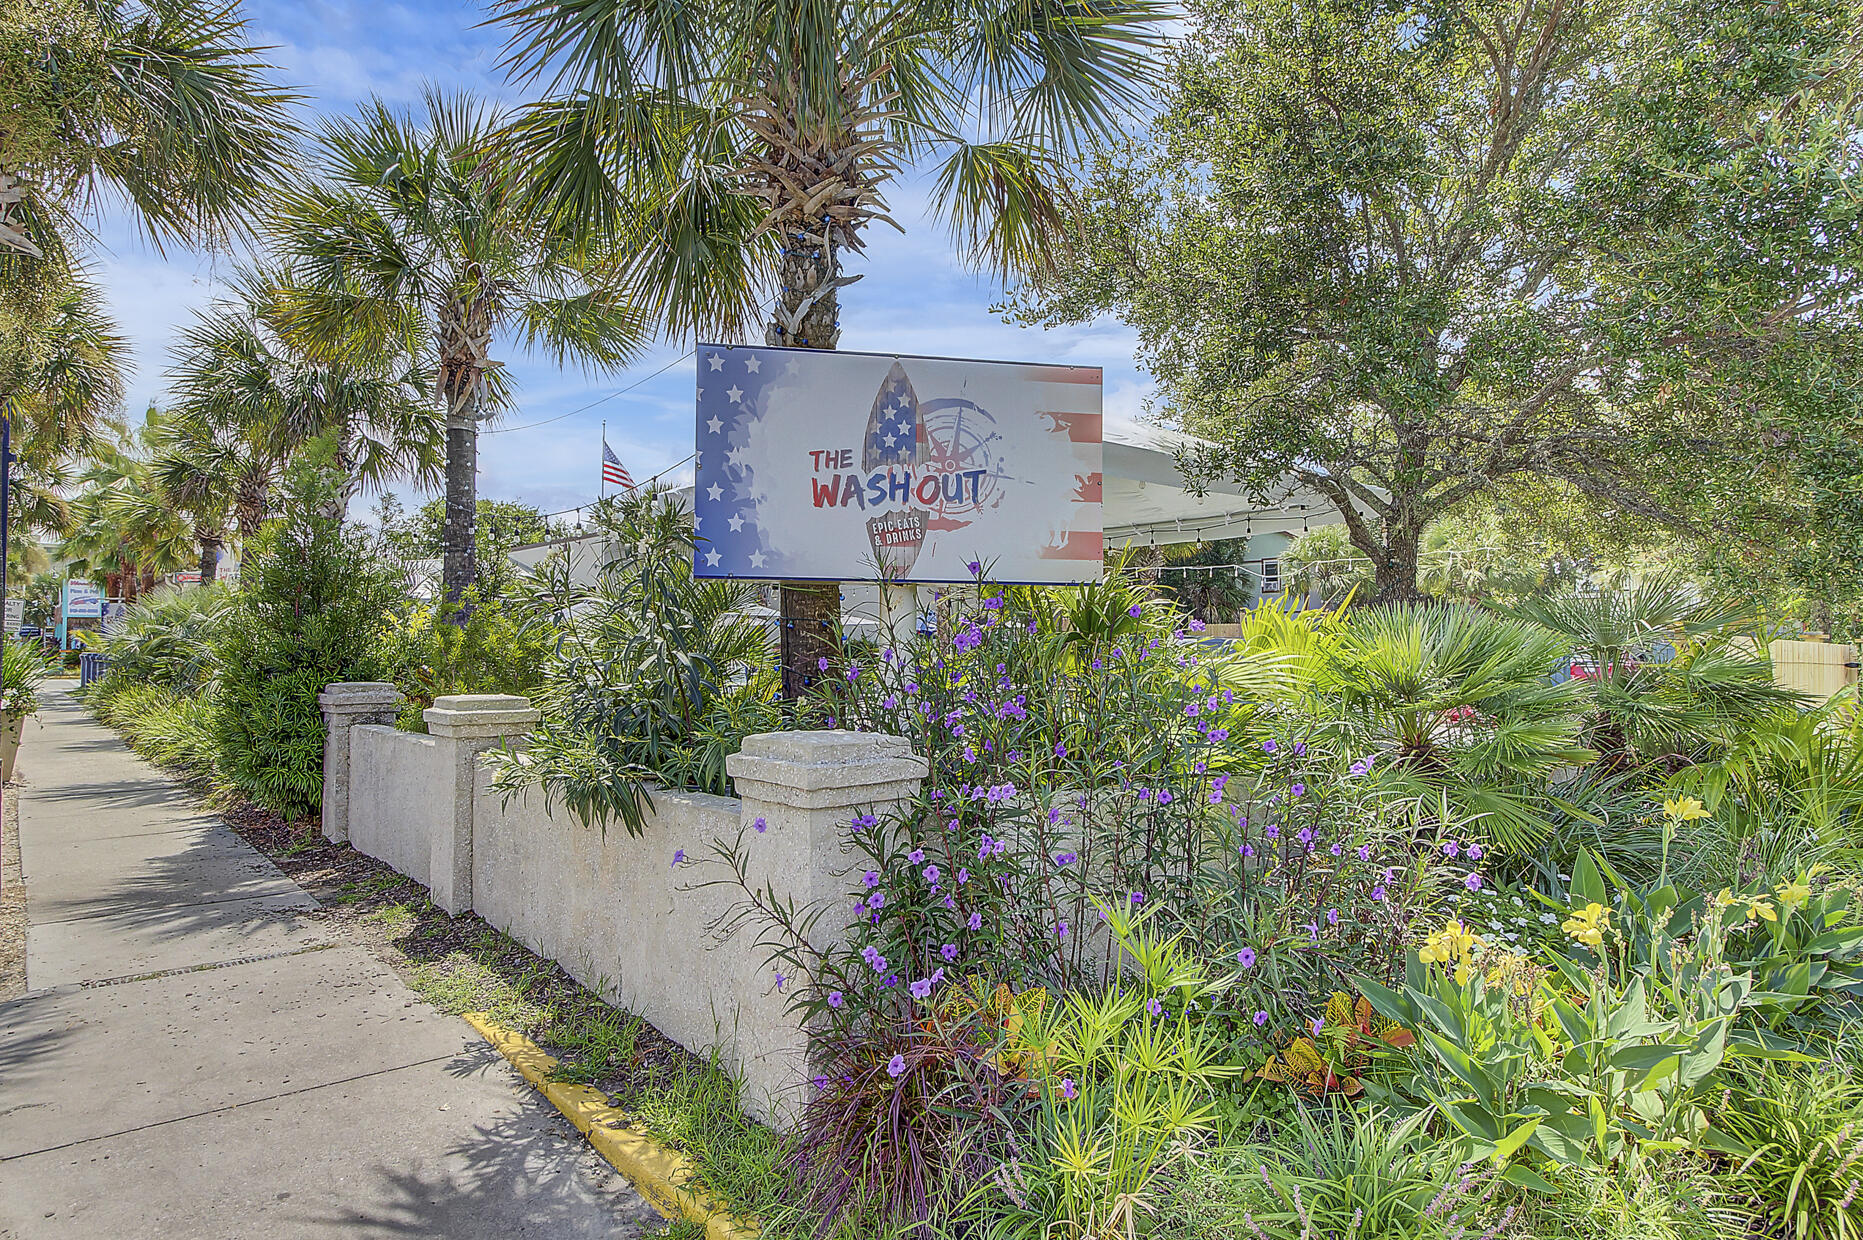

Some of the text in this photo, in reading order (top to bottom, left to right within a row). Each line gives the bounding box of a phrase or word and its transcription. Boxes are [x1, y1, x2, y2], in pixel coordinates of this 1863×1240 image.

[809, 449, 853, 472] THE
[811, 469, 987, 511] WASHOUT
[872, 516, 920, 535] EPIC EATS
[874, 528, 922, 546] & DRINKS
